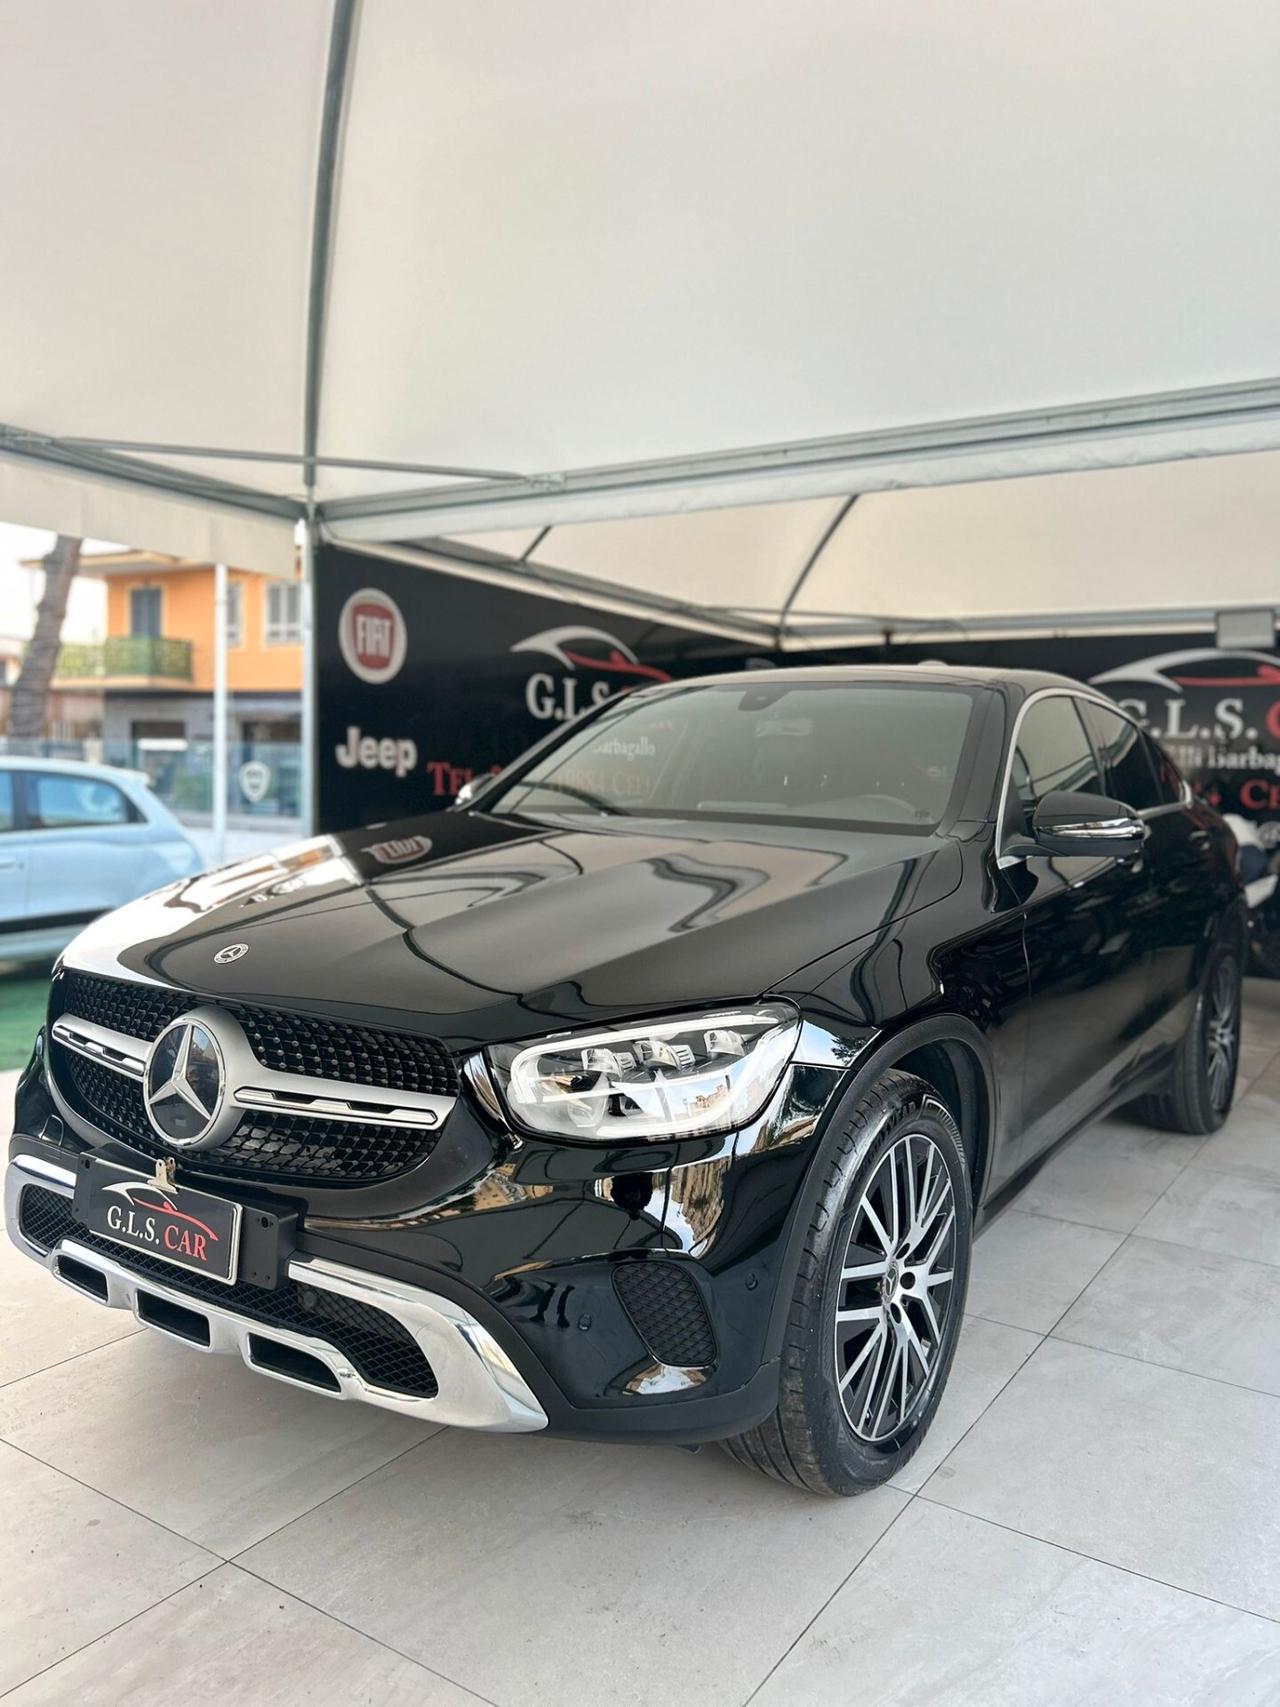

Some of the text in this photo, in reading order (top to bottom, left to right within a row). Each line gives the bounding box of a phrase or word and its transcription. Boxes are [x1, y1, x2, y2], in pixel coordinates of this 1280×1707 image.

[355, 613, 393, 658] FIAT
[335, 725, 419, 778] Jeep
[106, 1205, 207, 1261] G.L.S. CAR
